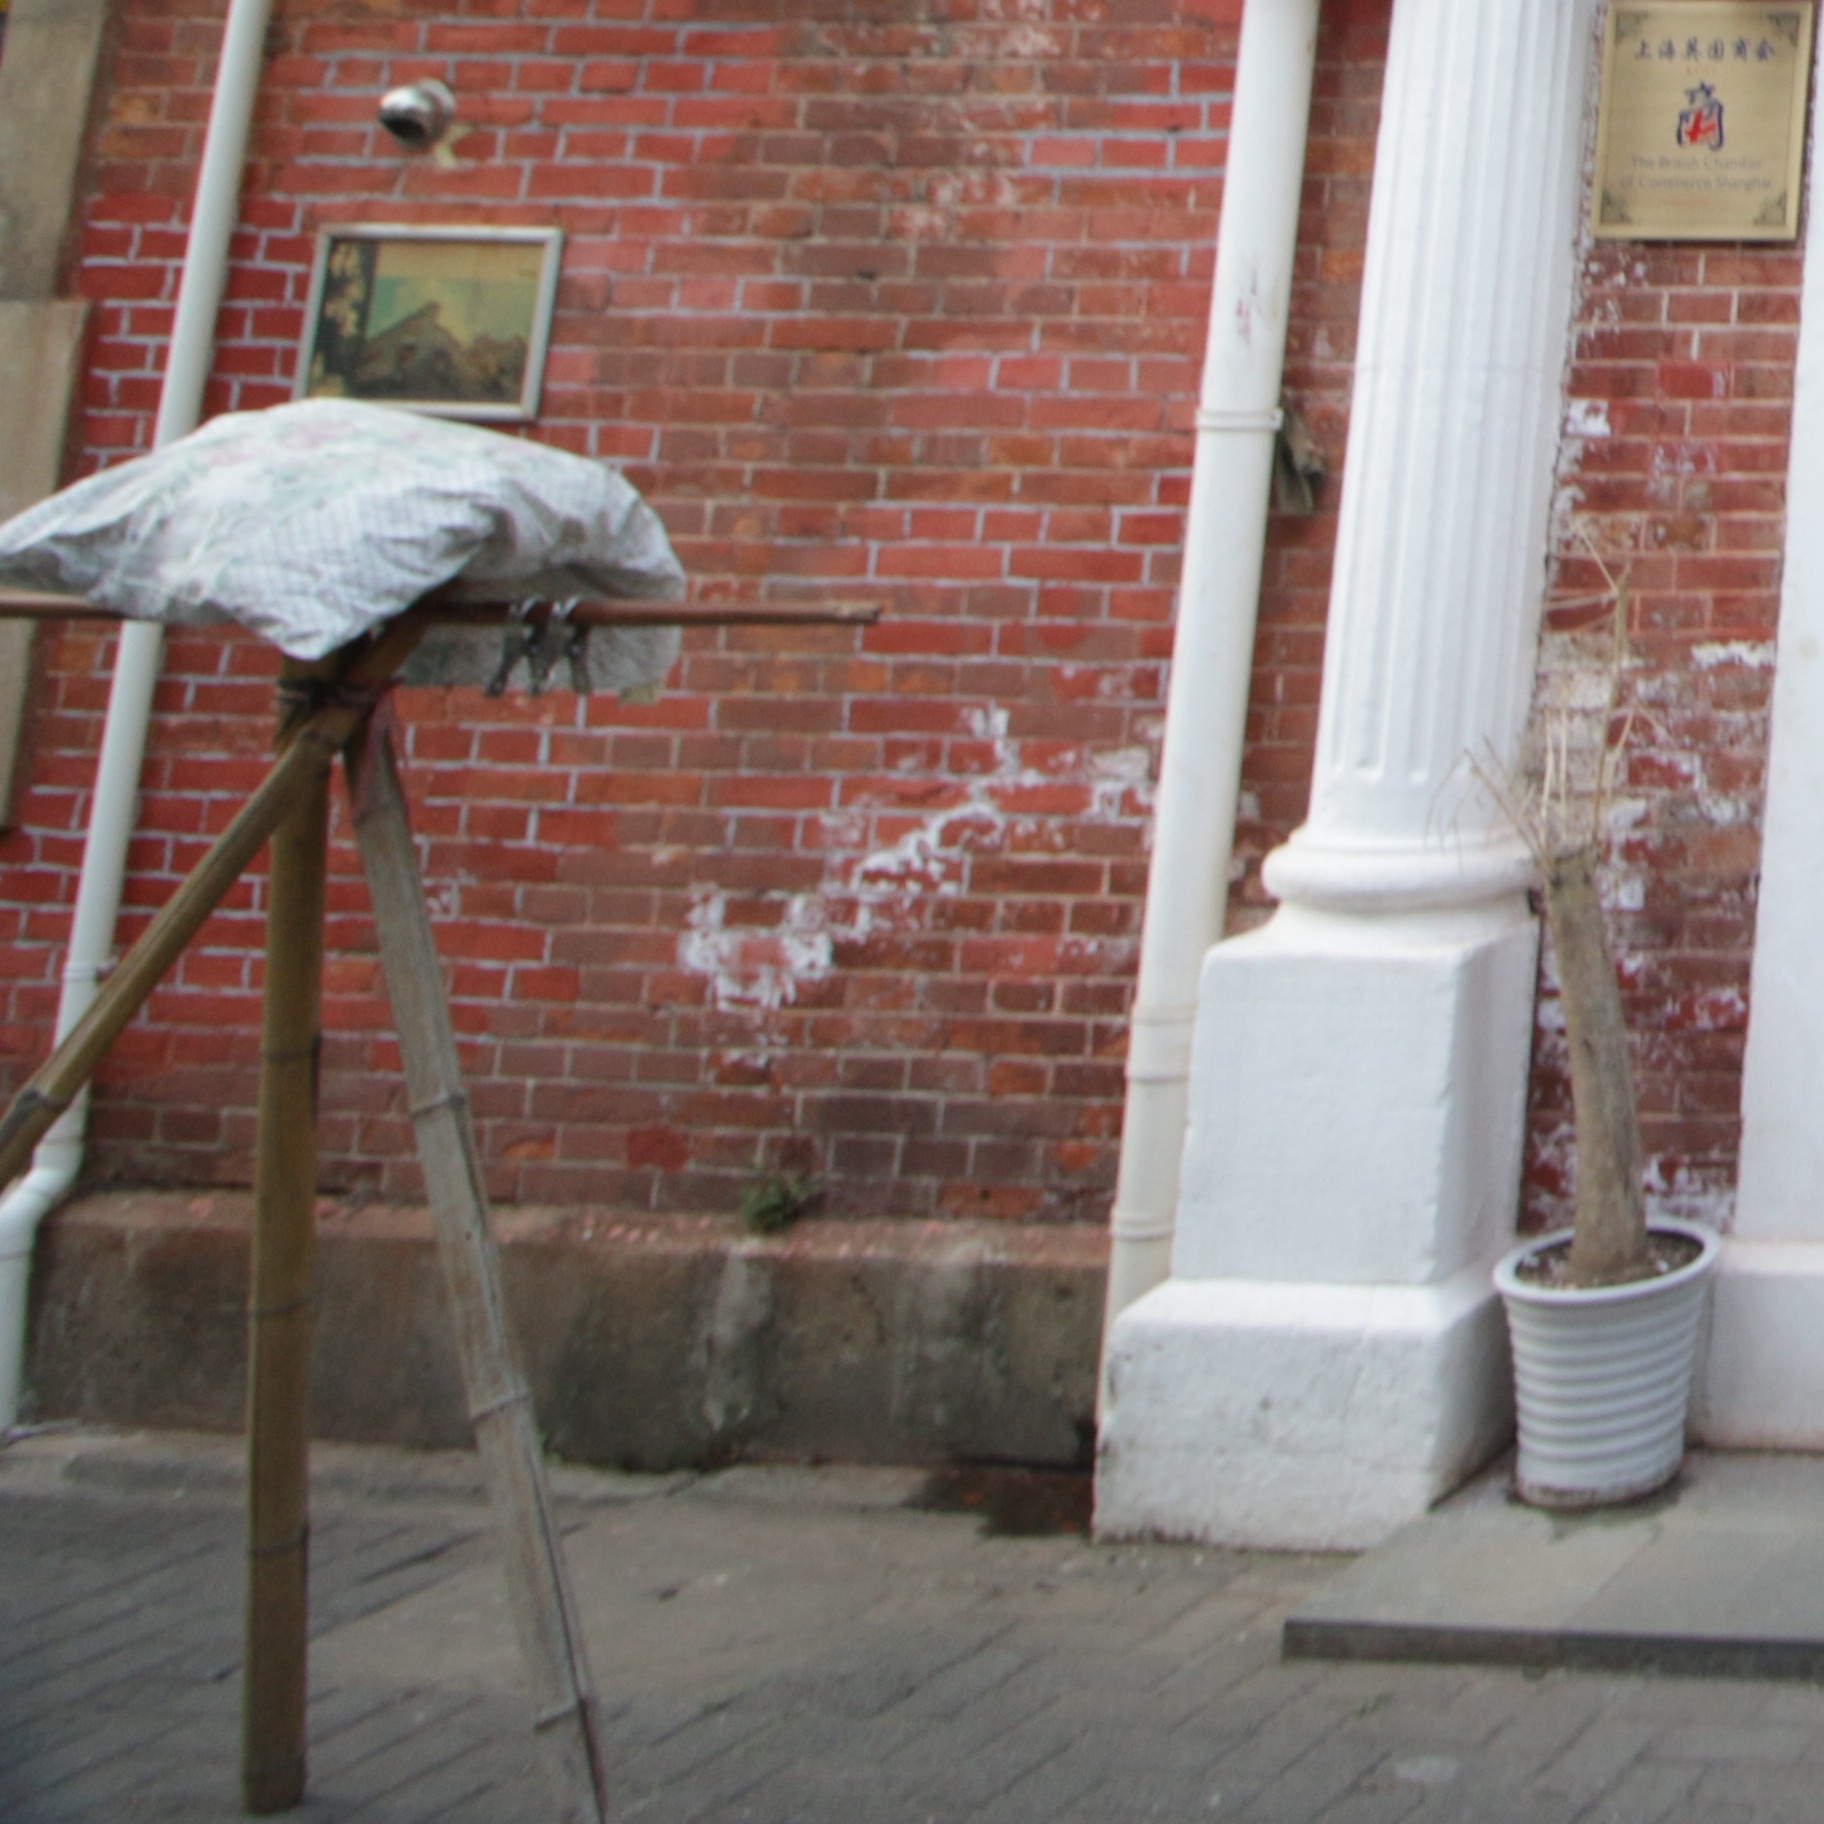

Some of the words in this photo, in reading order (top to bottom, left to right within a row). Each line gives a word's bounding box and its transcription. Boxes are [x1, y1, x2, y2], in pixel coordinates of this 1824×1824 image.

[1635, 36, 1775, 62] 上海英国商会
